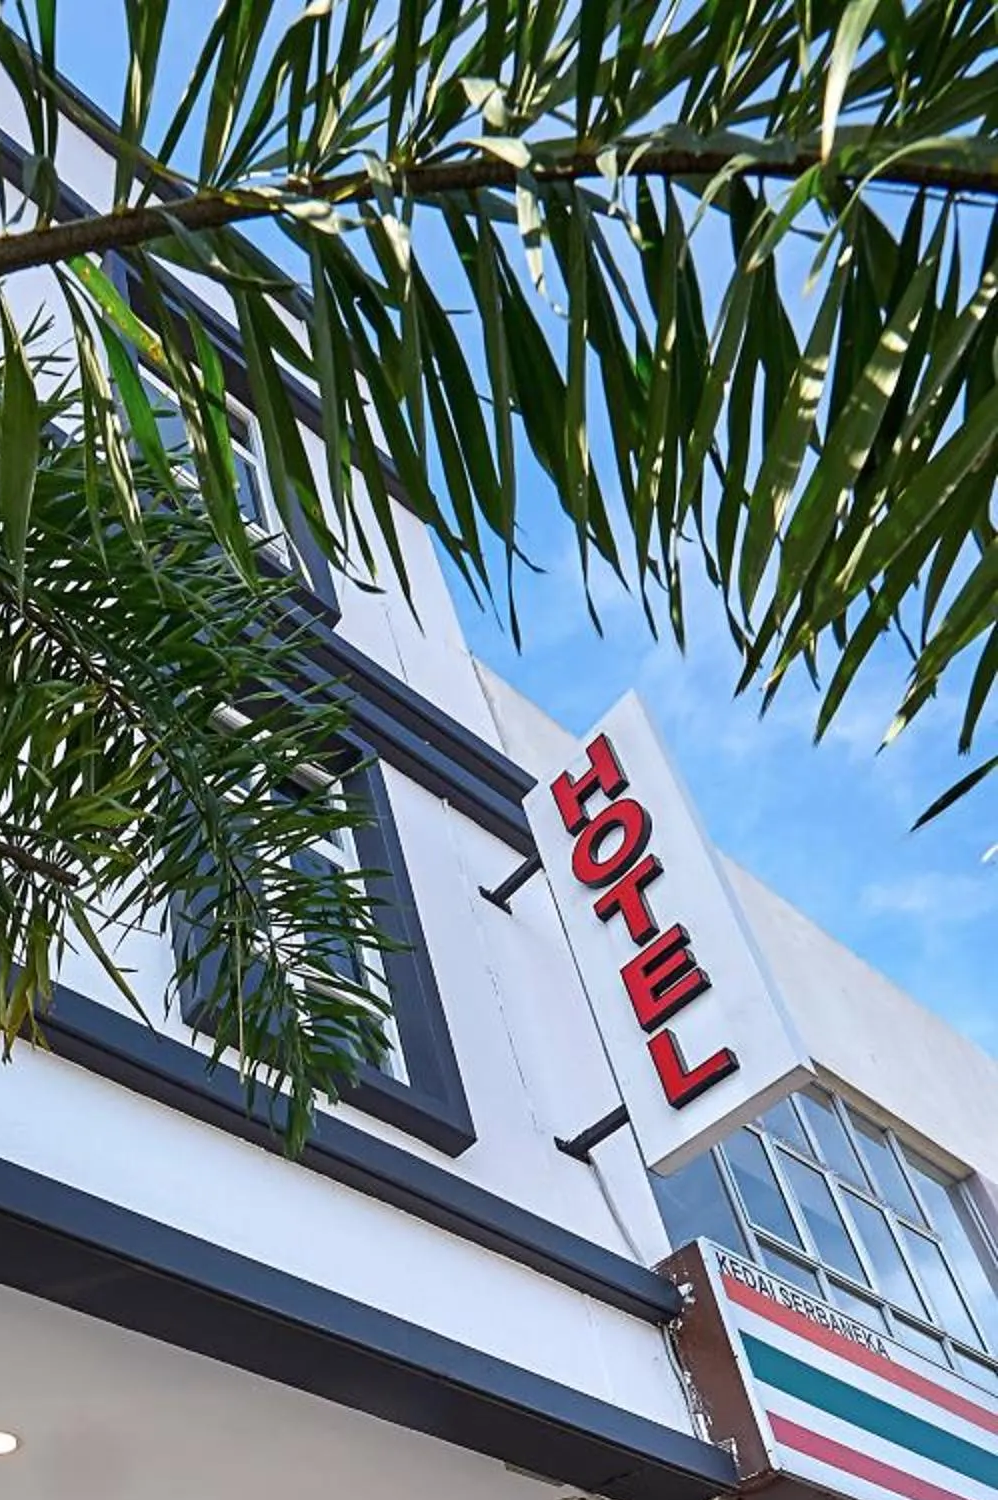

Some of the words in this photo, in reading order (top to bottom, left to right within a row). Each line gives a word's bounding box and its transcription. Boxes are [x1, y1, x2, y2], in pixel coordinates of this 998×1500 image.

[550, 732, 740, 1110] HOTEL
[715, 1252, 776, 1302] KEDAI
[779, 1287, 891, 1361] SERBANEKA
